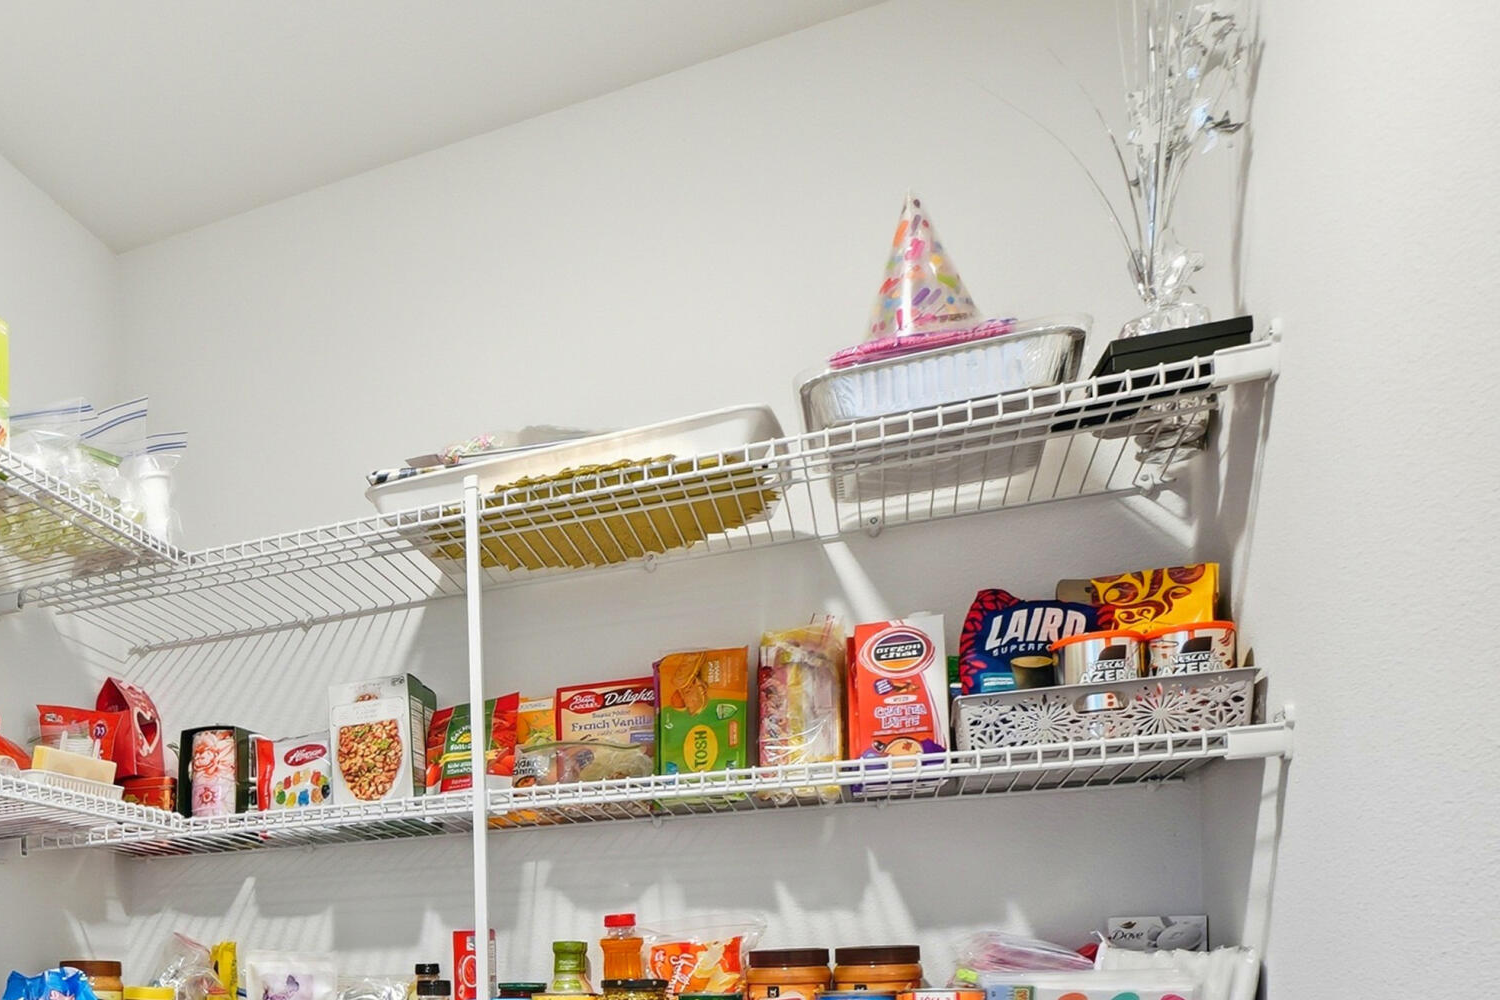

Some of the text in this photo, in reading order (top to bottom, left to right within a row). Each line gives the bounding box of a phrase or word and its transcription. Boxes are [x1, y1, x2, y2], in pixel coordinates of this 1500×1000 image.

[985, 608, 1087, 651] LAIRD
[876, 643, 922, 655] oregon
[879, 650, 919, 660] chai
[903, 704, 927, 715] TEA
[571, 720, 610, 732] French
[880, 716, 921, 728] LATTE
[694, 730, 708, 769] TOSH
[1112, 929, 1145, 942] Dove
